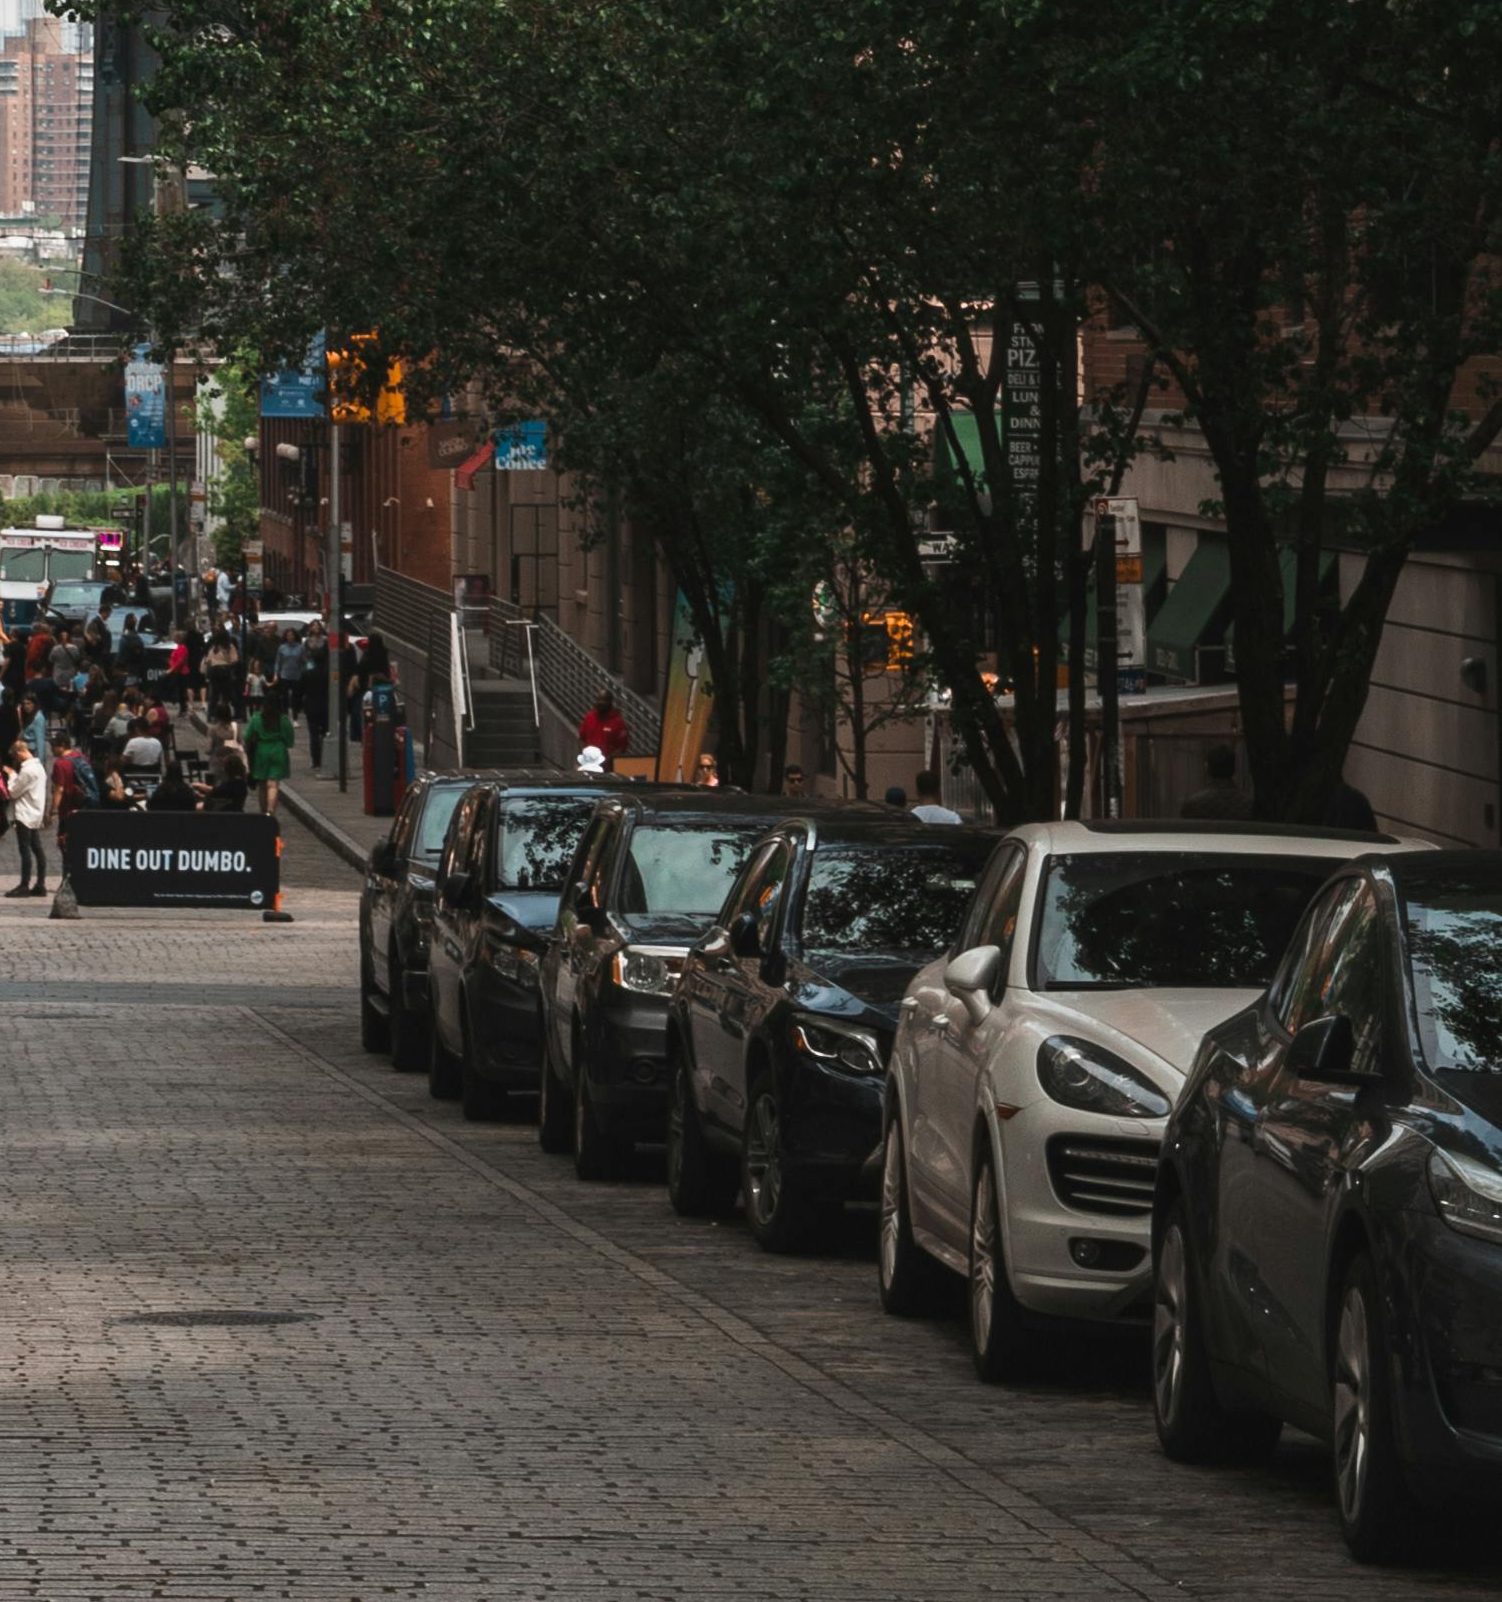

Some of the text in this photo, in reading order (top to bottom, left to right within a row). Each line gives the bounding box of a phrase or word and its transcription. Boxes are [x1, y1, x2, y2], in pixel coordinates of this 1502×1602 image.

[1030, 405, 1041, 416] &
[1010, 442, 1032, 453] BEER
[87, 847, 251, 873] DINE OUT DUMBO.
